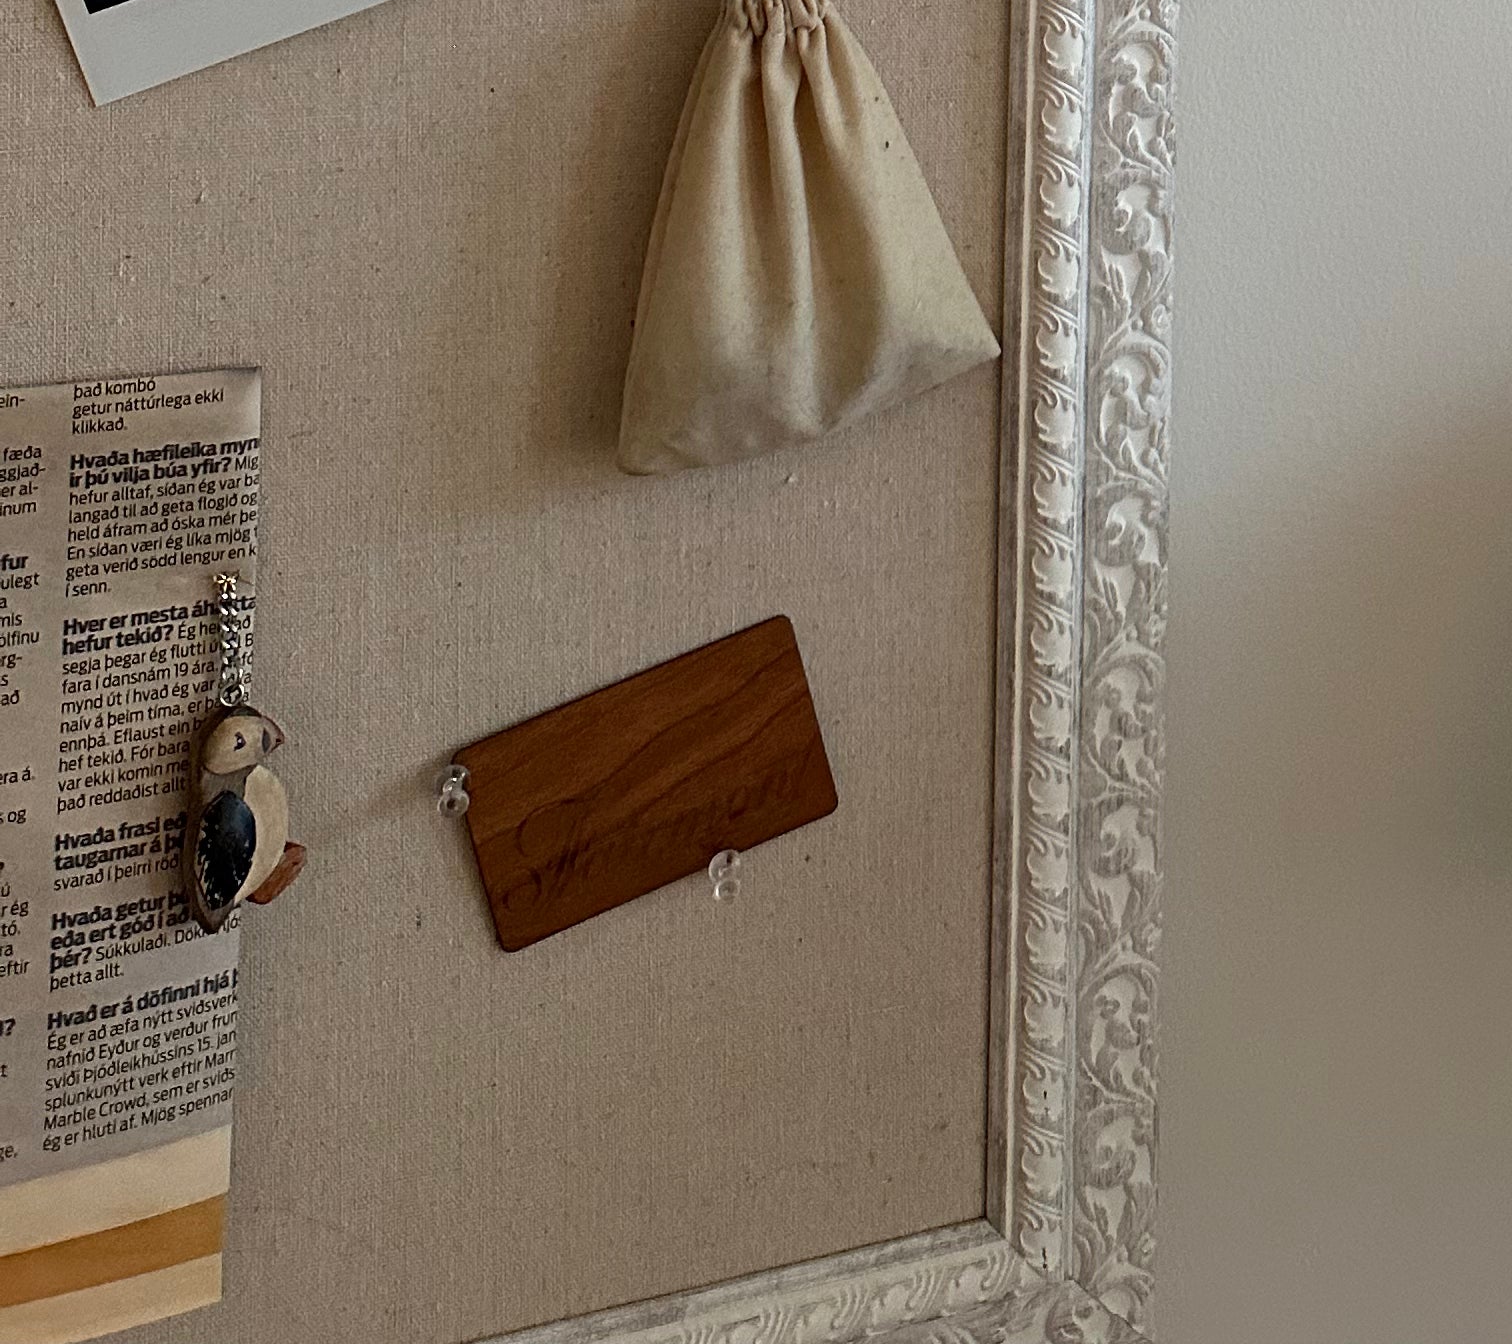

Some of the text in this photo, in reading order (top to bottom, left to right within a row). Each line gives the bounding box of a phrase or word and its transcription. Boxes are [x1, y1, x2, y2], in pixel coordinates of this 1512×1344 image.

[73, 388, 224, 419] getur náttúrlega ekki
[74, 377, 156, 401] það kombó
[71, 442, 217, 470] Hvaða hæfileika
[112, 457, 230, 484] vilja búa yfir?
[70, 490, 109, 506] hefur
[157, 482, 195, 497] síðan
[219, 478, 240, 490] var
[69, 494, 238, 524] langað til geta flogið
[68, 511, 236, 542] held áfram óska mér
[89, 529, 250, 558] síðan væri líka mjög
[66, 562, 99, 581] geta
[103, 558, 138, 574] verið
[181, 549, 225, 565] lengur
[64, 607, 189, 635] Hver mesta
[62, 634, 112, 655] hefur
[62, 642, 206, 675] segja þegar flutti
[62, 667, 171, 694] fara dansnám
[62, 679, 215, 714] mynd hvað var
[107, 711, 144, 729] þeim
[114, 720, 190, 745] Eflaust ein
[59, 756, 85, 773] hef
[131, 744, 154, 760] Fór
[157, 740, 190, 756] bara
[58, 763, 162, 792] var ekki komin
[57, 777, 186, 814] það reddaðist allt
[55, 817, 160, 851] Hvaða frasi
[55, 842, 146, 870] taugarnar
[54, 872, 104, 891] svarað
[52, 896, 165, 930] Hvaða getur
[51, 914, 154, 950] eða ert góð
[50, 971, 92, 992] þetta
[47, 1005, 97, 1030] Hvað
[203, 971, 229, 994] hjá
[110, 1018, 139, 1036] æfa
[47, 1021, 209, 1070] nafnið Eyður verður
[46, 1069, 80, 1091] sviði
[139, 1067, 169, 1086] verk
[171, 1059, 202, 1078] eftir
[44, 1108, 96, 1130] Marble
[153, 1085, 183, 1103] sem
[82, 1107, 176, 1142] hluti Mjög
